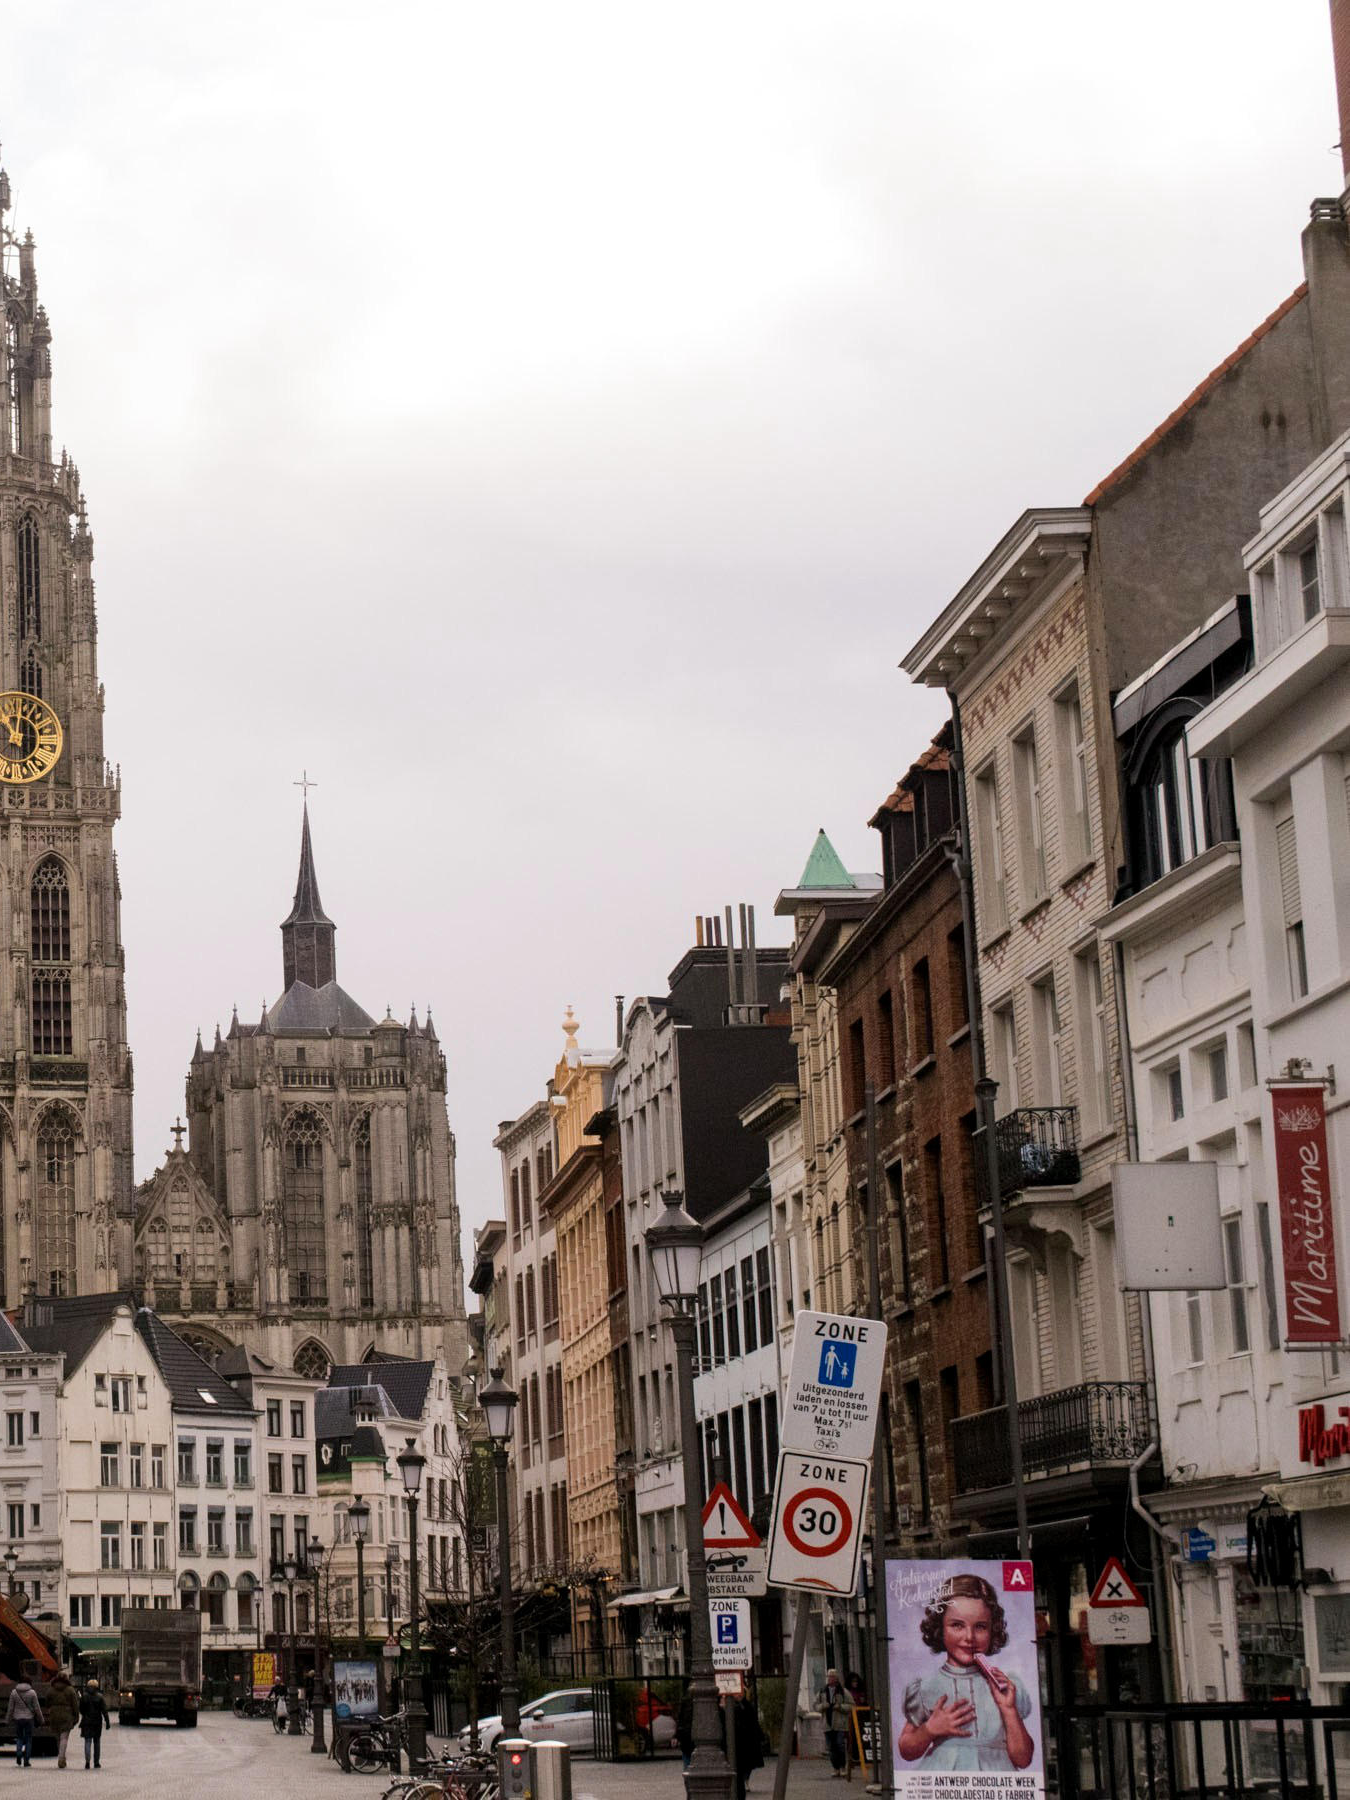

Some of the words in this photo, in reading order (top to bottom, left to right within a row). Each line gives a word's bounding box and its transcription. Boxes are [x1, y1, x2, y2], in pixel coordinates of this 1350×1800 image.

[1290, 1140, 1333, 1326] Maritime
[814, 1320, 869, 1343] ZONE
[802, 1382, 864, 1401] Uitgezonderd
[796, 1392, 822, 1404] laden
[824, 1398, 835, 1406] en
[837, 1399, 868, 1411] lossen
[793, 1403, 809, 1412] van
[811, 1404, 818, 1413] 7
[828, 1407, 842, 1418] tot
[844, 1409, 851, 1419] 11
[852, 1413, 869, 1421] uur
[813, 1415, 836, 1427] Max.
[816, 1426, 841, 1438] Taxi's
[1298, 1403, 1350, 1467] Mari
[800, 1463, 848, 1483] ZONE
[799, 1507, 837, 1536] 30
[706, 1574, 755, 1584] WEEGBAAR
[1010, 1568, 1026, 1585] A
[711, 1601, 739, 1612] ZONE
[721, 1617, 732, 1632] P
[713, 1657, 749, 1667] erhaling
[934, 1775, 970, 1787] ANTWERP
[971, 1776, 1013, 1787] CHOCOLATE
[1015, 1776, 1036, 1787] WEEK
[934, 1789, 995, 1800] CHOCOLADESTAD
[1005, 1790, 1036, 1800] FABRIEK
